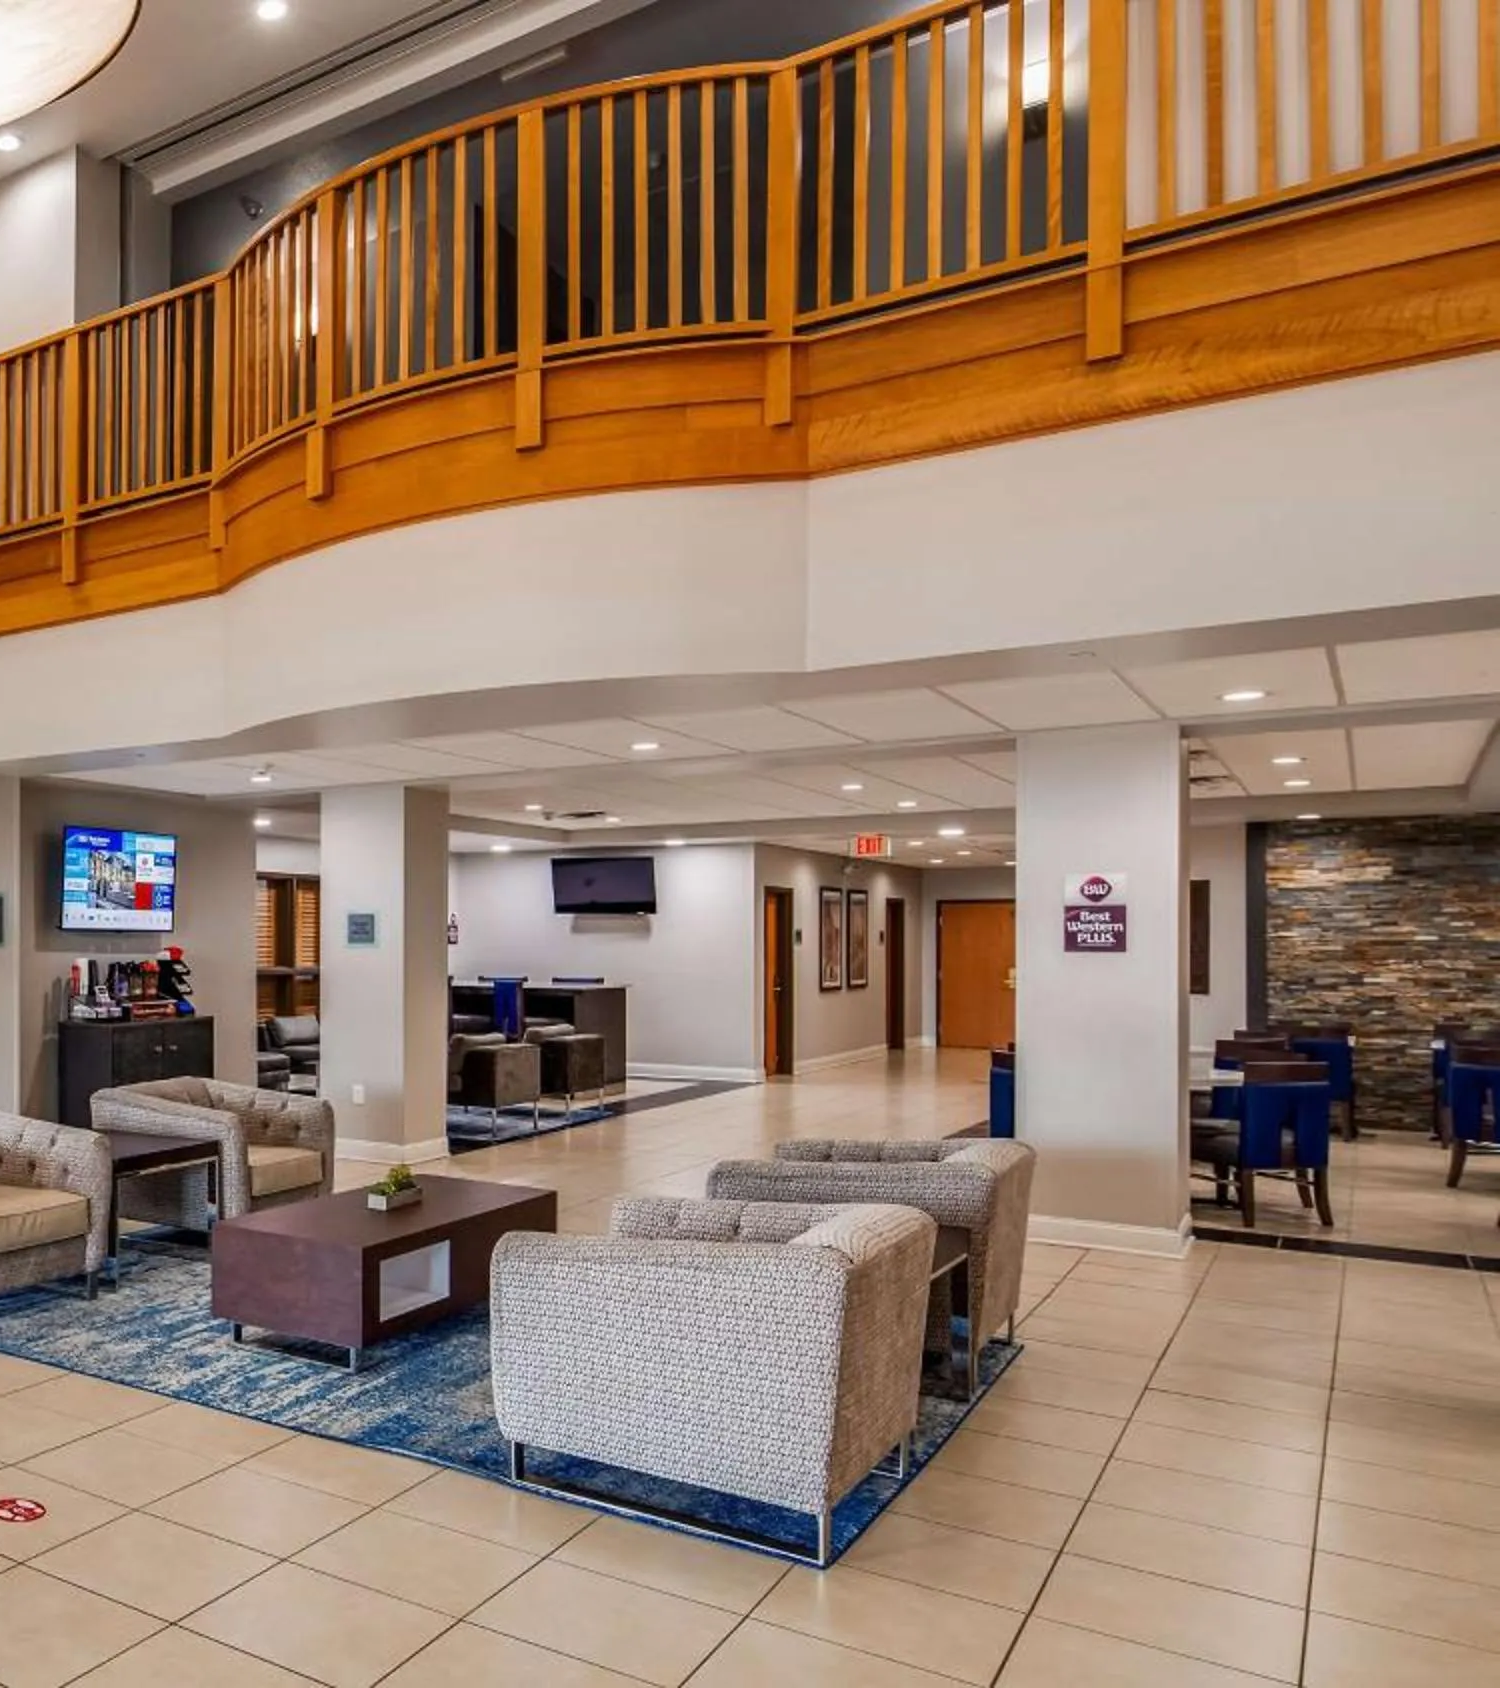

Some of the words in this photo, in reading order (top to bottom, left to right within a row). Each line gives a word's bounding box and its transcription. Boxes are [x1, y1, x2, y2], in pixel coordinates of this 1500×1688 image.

[1083, 883, 1109, 895] BW
[1080, 911, 1111, 921] Best
[1067, 921, 1124, 932] Western
